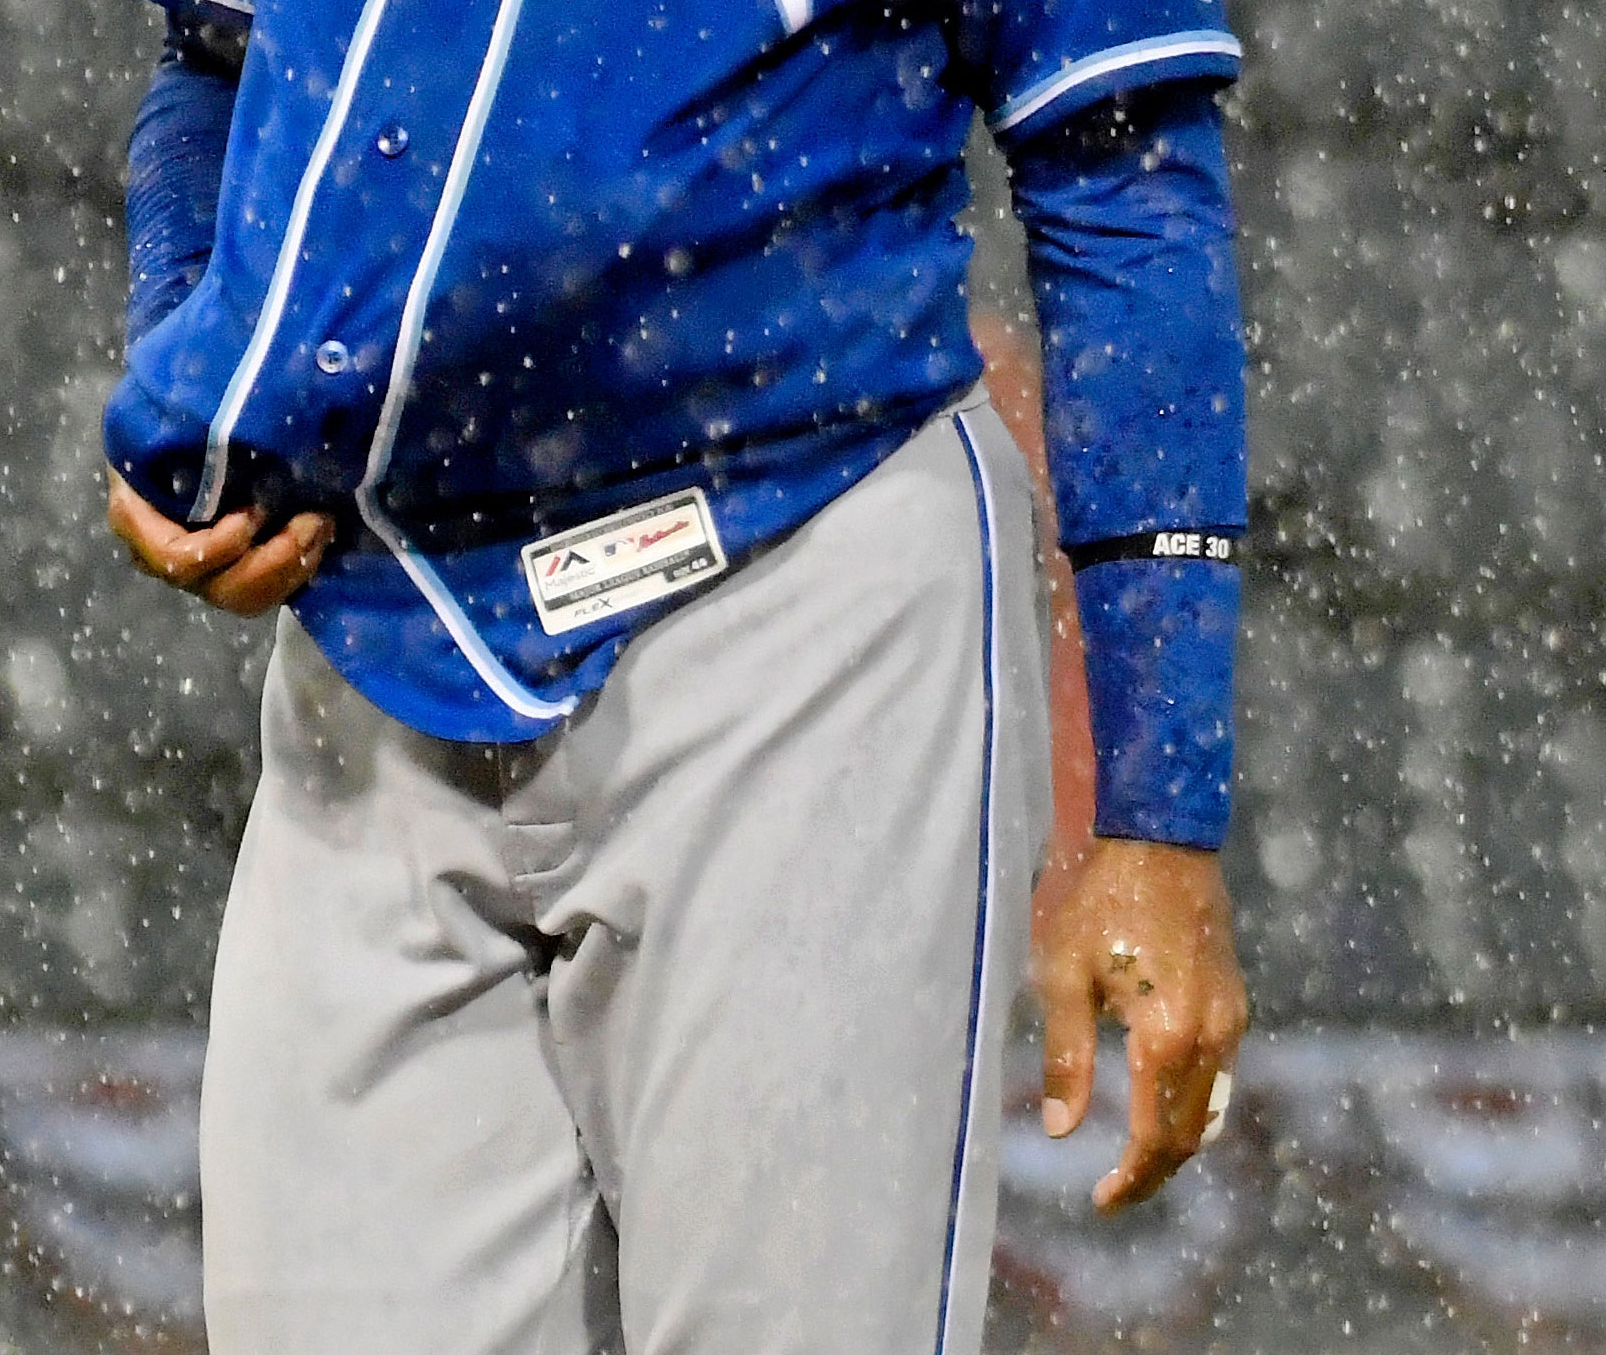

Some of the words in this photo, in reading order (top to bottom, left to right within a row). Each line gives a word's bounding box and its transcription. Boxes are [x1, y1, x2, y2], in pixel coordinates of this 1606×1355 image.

[1153, 532, 1200, 556] ACE
[1205, 536, 1229, 559] 30
[545, 566, 595, 590] Majestic
